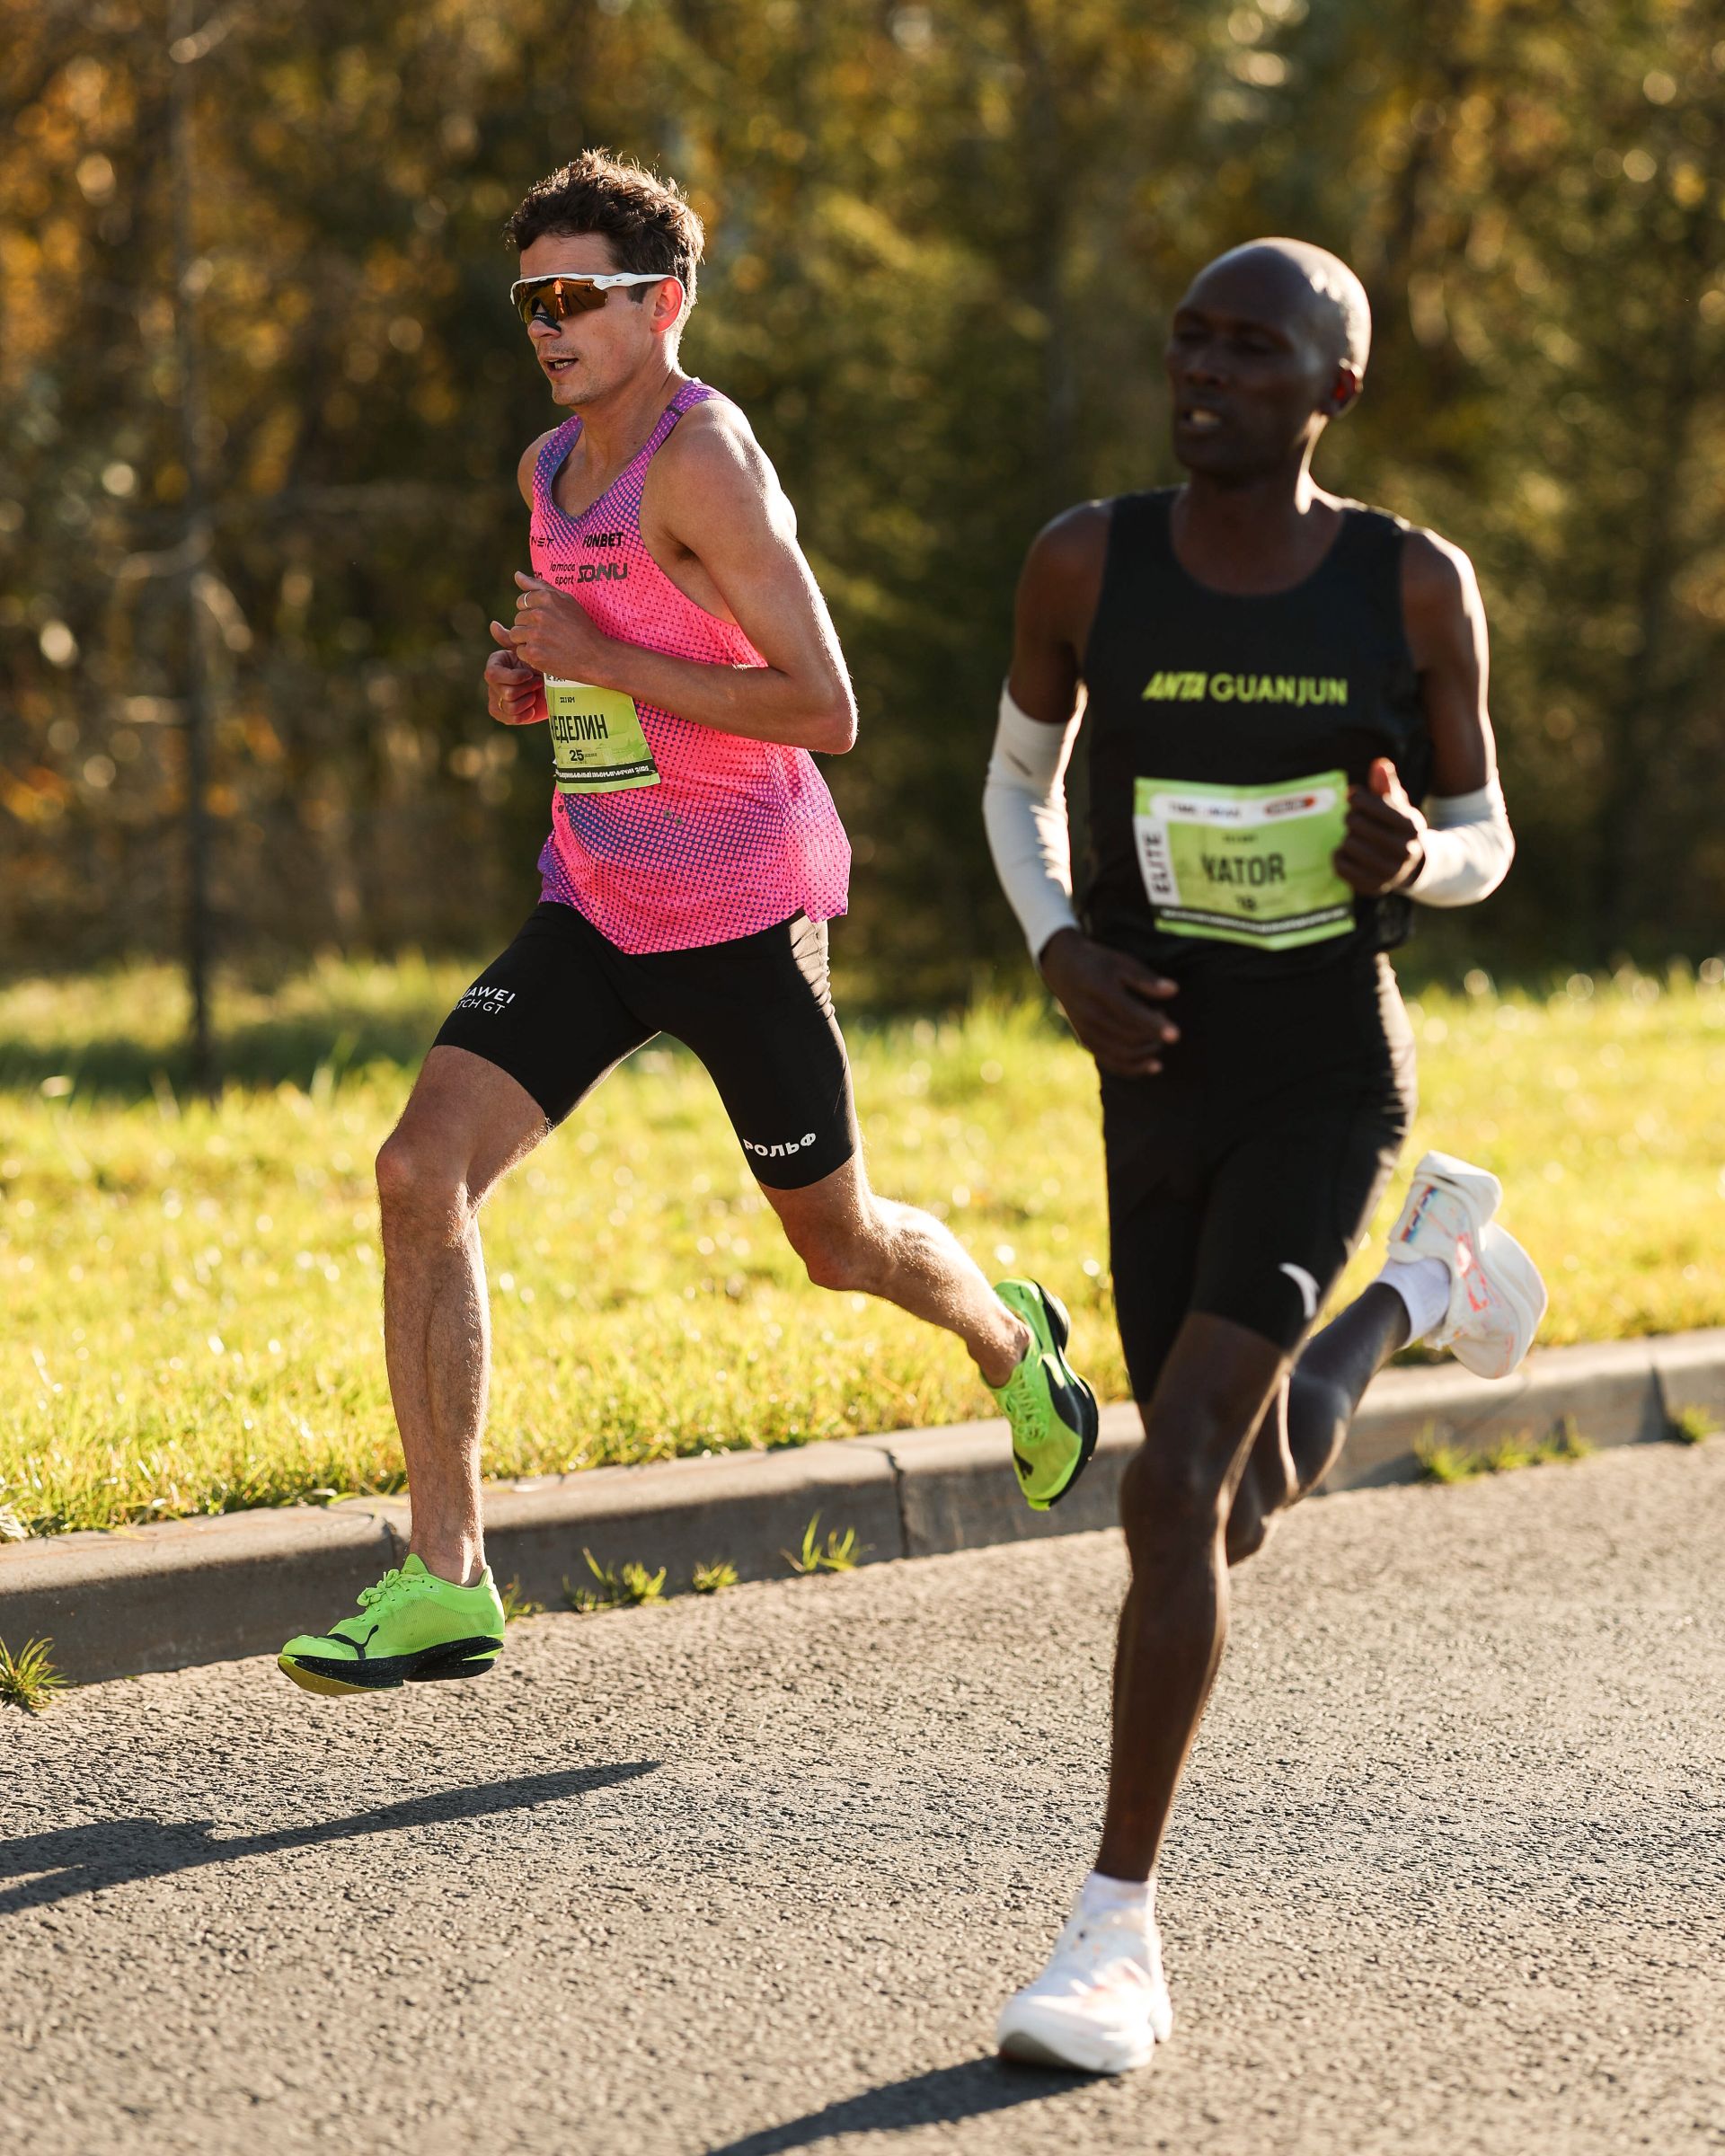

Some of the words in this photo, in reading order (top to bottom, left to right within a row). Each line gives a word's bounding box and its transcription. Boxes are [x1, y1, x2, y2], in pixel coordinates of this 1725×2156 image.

[555, 575, 574, 586] sport
[1209, 673, 1348, 708] GUANJUN
[569, 749, 585, 765] 25
[1145, 834, 1171, 895] ELITE
[482, 1002, 506, 1014] GT
[742, 1133, 817, 1158] РОЛЬФ
